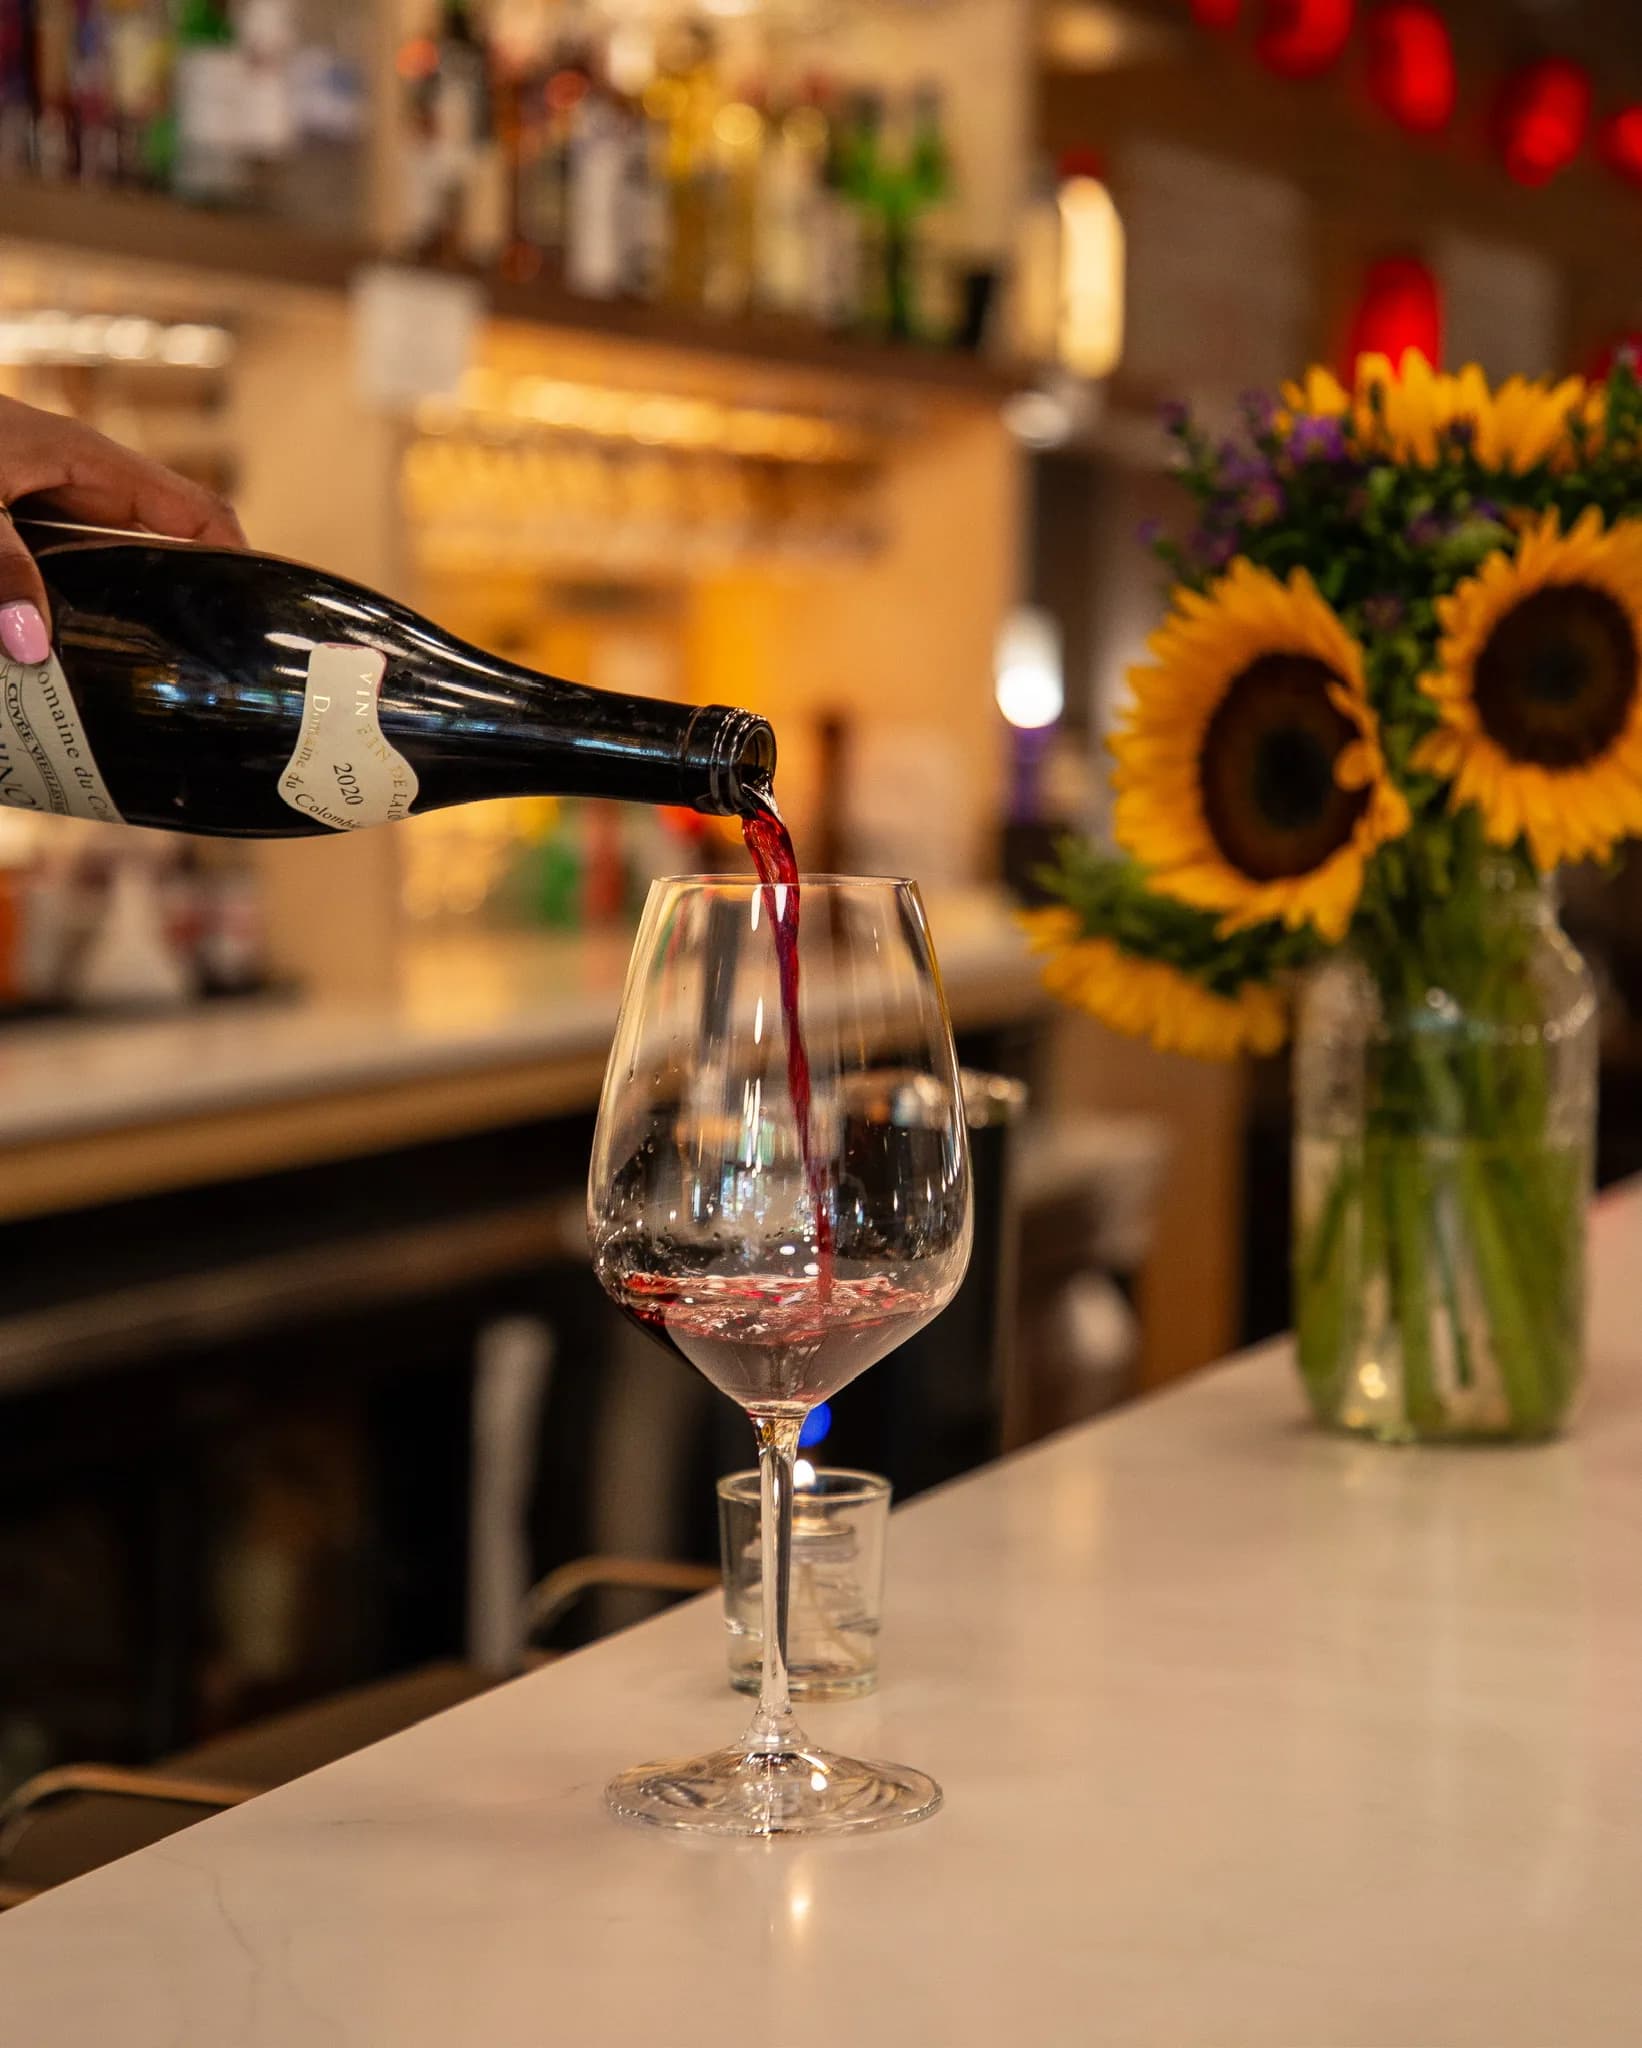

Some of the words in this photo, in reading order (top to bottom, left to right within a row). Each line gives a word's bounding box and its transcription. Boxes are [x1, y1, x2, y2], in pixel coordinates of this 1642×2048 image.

[355, 672, 373, 717] VIN
[37, 671, 80, 759] omaine
[74, 766, 94, 789] du
[296, 695, 331, 768] Domaine
[285, 772, 304, 789] du
[333, 762, 364, 805] 2020
[295, 793, 357, 829] Colomb
